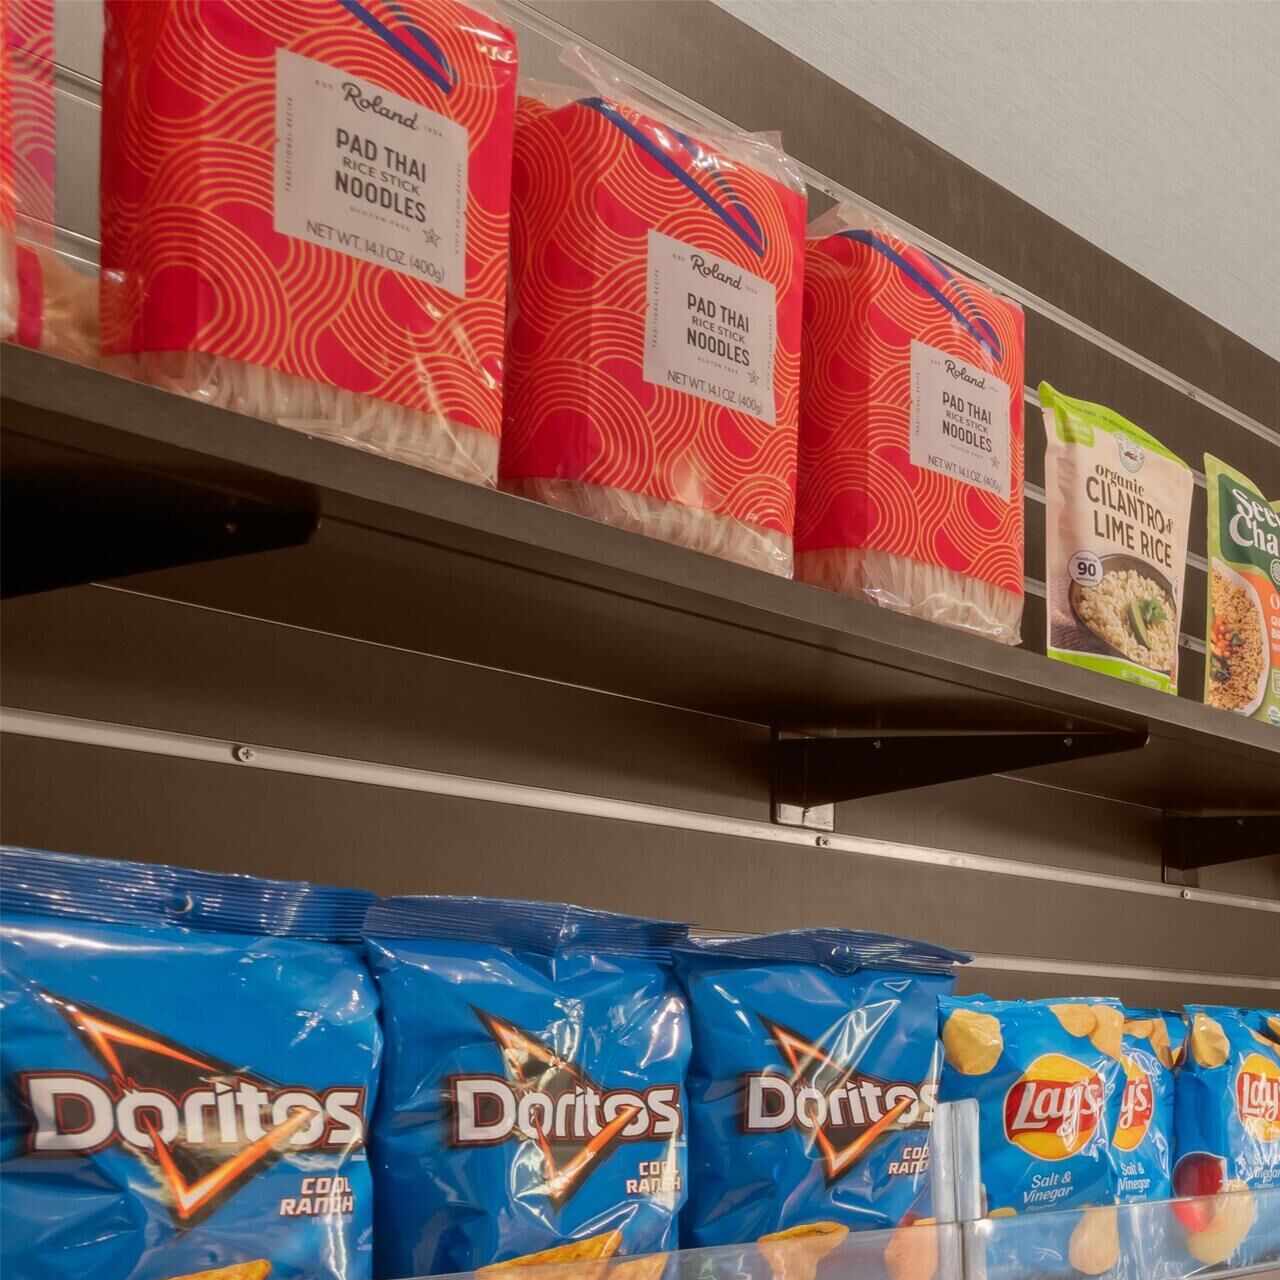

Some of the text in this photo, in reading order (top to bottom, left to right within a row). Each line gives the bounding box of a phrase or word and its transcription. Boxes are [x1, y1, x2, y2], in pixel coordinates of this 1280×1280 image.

[341, 81, 418, 131] Roland
[336, 127, 427, 184] PAD THAI
[343, 156, 421, 197] RICE STICK
[334, 170, 427, 223] NOODLES
[306, 219, 334, 243] NET
[409, 255, 445, 284] (400g)
[690, 254, 742, 290] Roland
[687, 292, 749, 333] PAD THAI
[687, 327, 750, 367] NOODLES
[692, 316, 746, 345] RICE STICK
[944, 359, 986, 390] Roland
[942, 391, 992, 425] PAD THAI
[946, 410, 988, 434] RICE STICK
[942, 420, 992, 453] NOODLES
[1095, 463, 1145, 497] organic
[1086, 476, 1165, 535] CILANTRO
[1094, 510, 1172, 569] LIME RICE
[1077, 561, 1097, 577] 90
[26, 1076, 364, 1151] Doritos
[452, 1077, 680, 1142] Doritos
[748, 1075, 939, 1132] Doritos
[1011, 1080, 1103, 1142] Lay's
[903, 1147, 930, 1161] COO
[1120, 1162, 1145, 1175] Salt &
[300, 1177, 351, 1196] COOL
[1023, 1184, 1073, 1204] Vinegar
[1031, 1171, 1072, 1188] Salt &
[1118, 1175, 1150, 1190] Vinegar
[279, 1196, 354, 1216] RANCH
